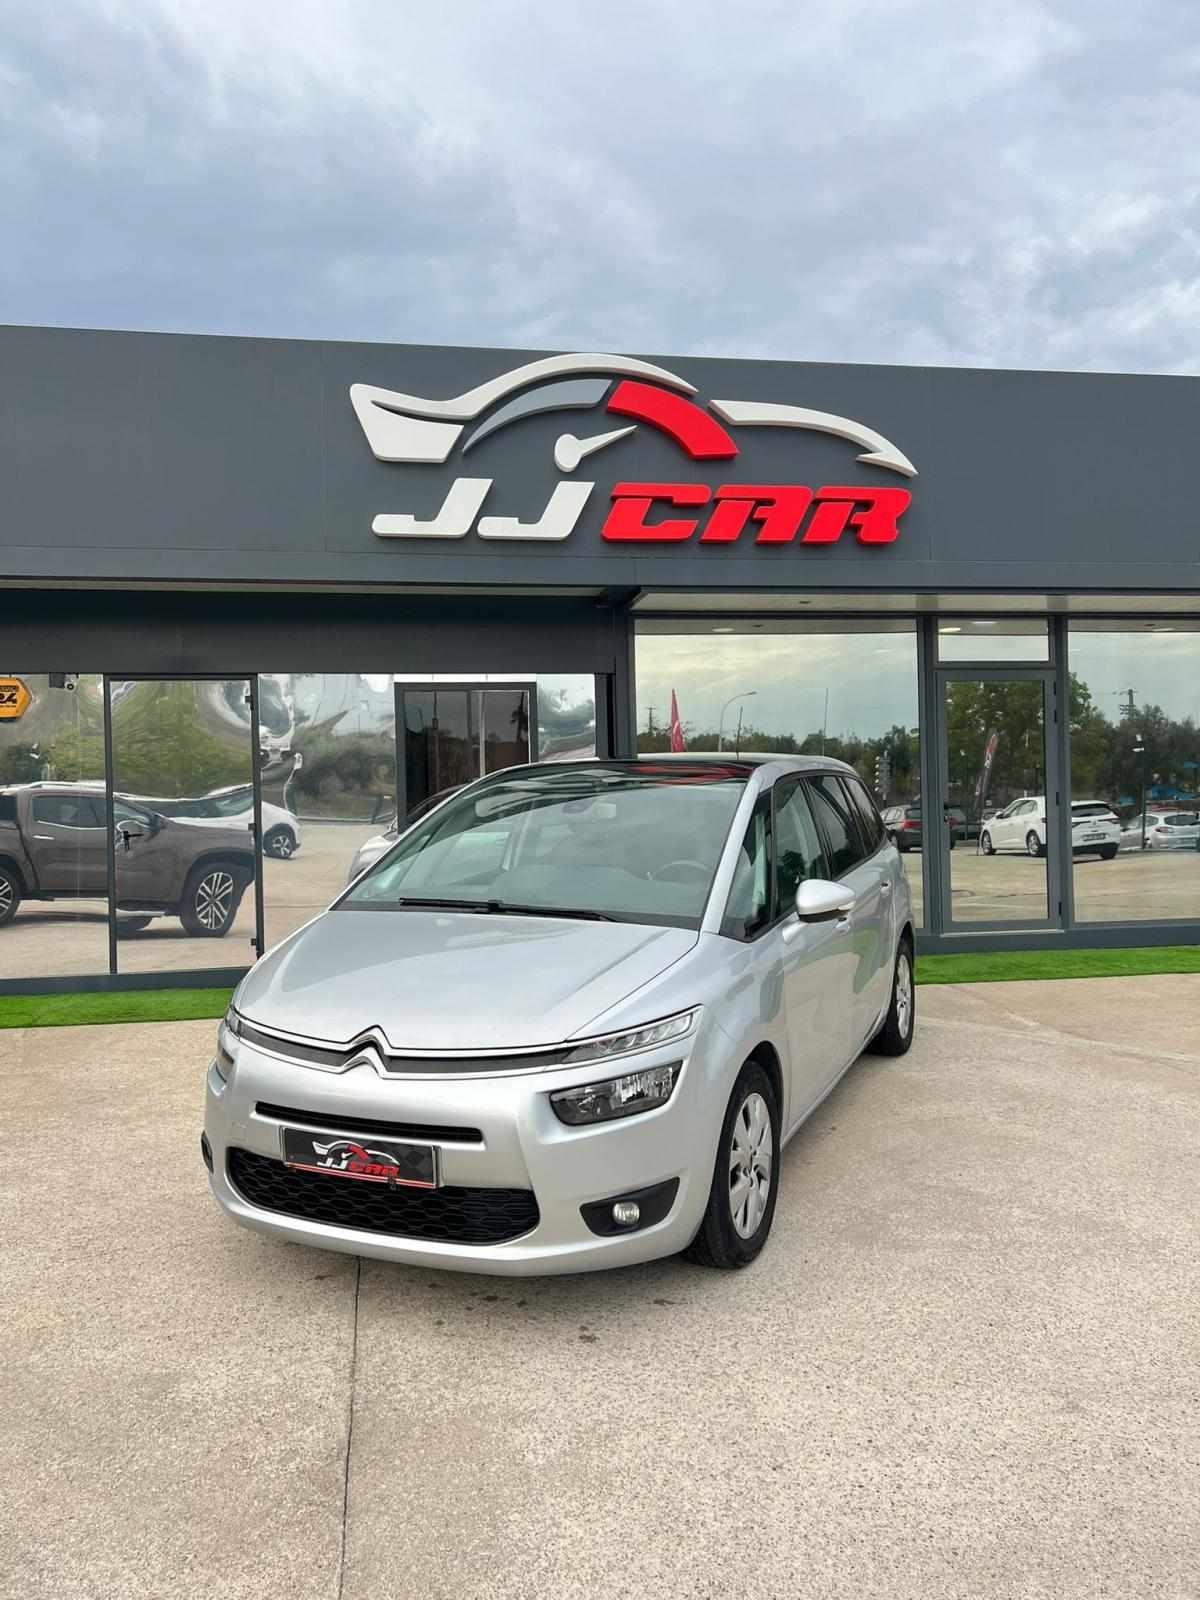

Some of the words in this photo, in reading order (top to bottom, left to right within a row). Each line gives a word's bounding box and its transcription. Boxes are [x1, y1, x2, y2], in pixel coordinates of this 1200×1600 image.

[372, 477, 595, 540] JJ
[601, 482, 911, 545] CAR
[317, 1158, 348, 1170] JJ
